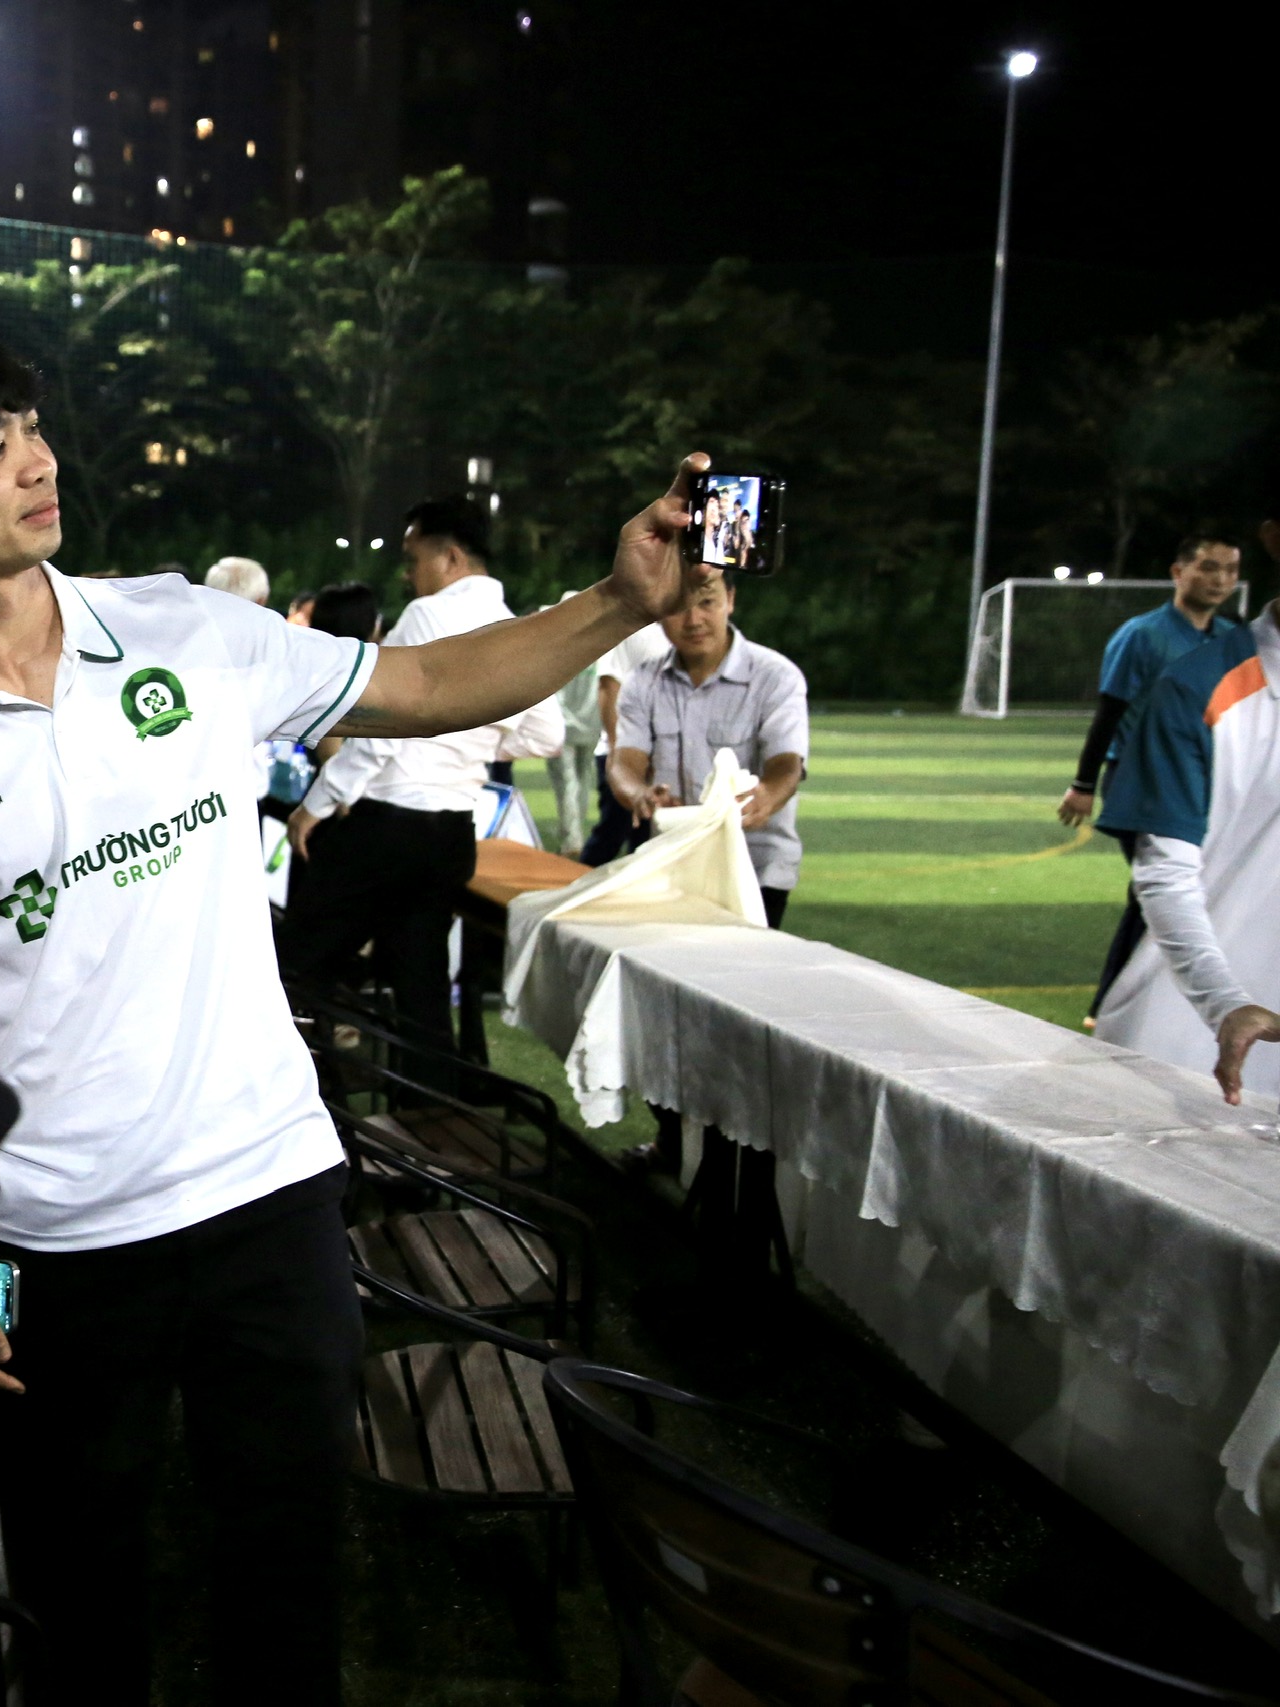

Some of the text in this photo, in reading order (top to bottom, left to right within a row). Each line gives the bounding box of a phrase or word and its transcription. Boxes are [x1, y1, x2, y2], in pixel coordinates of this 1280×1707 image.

[61, 791, 227, 889] TRƯỜNG TƯƠI
[113, 845, 182, 888] GROUP
